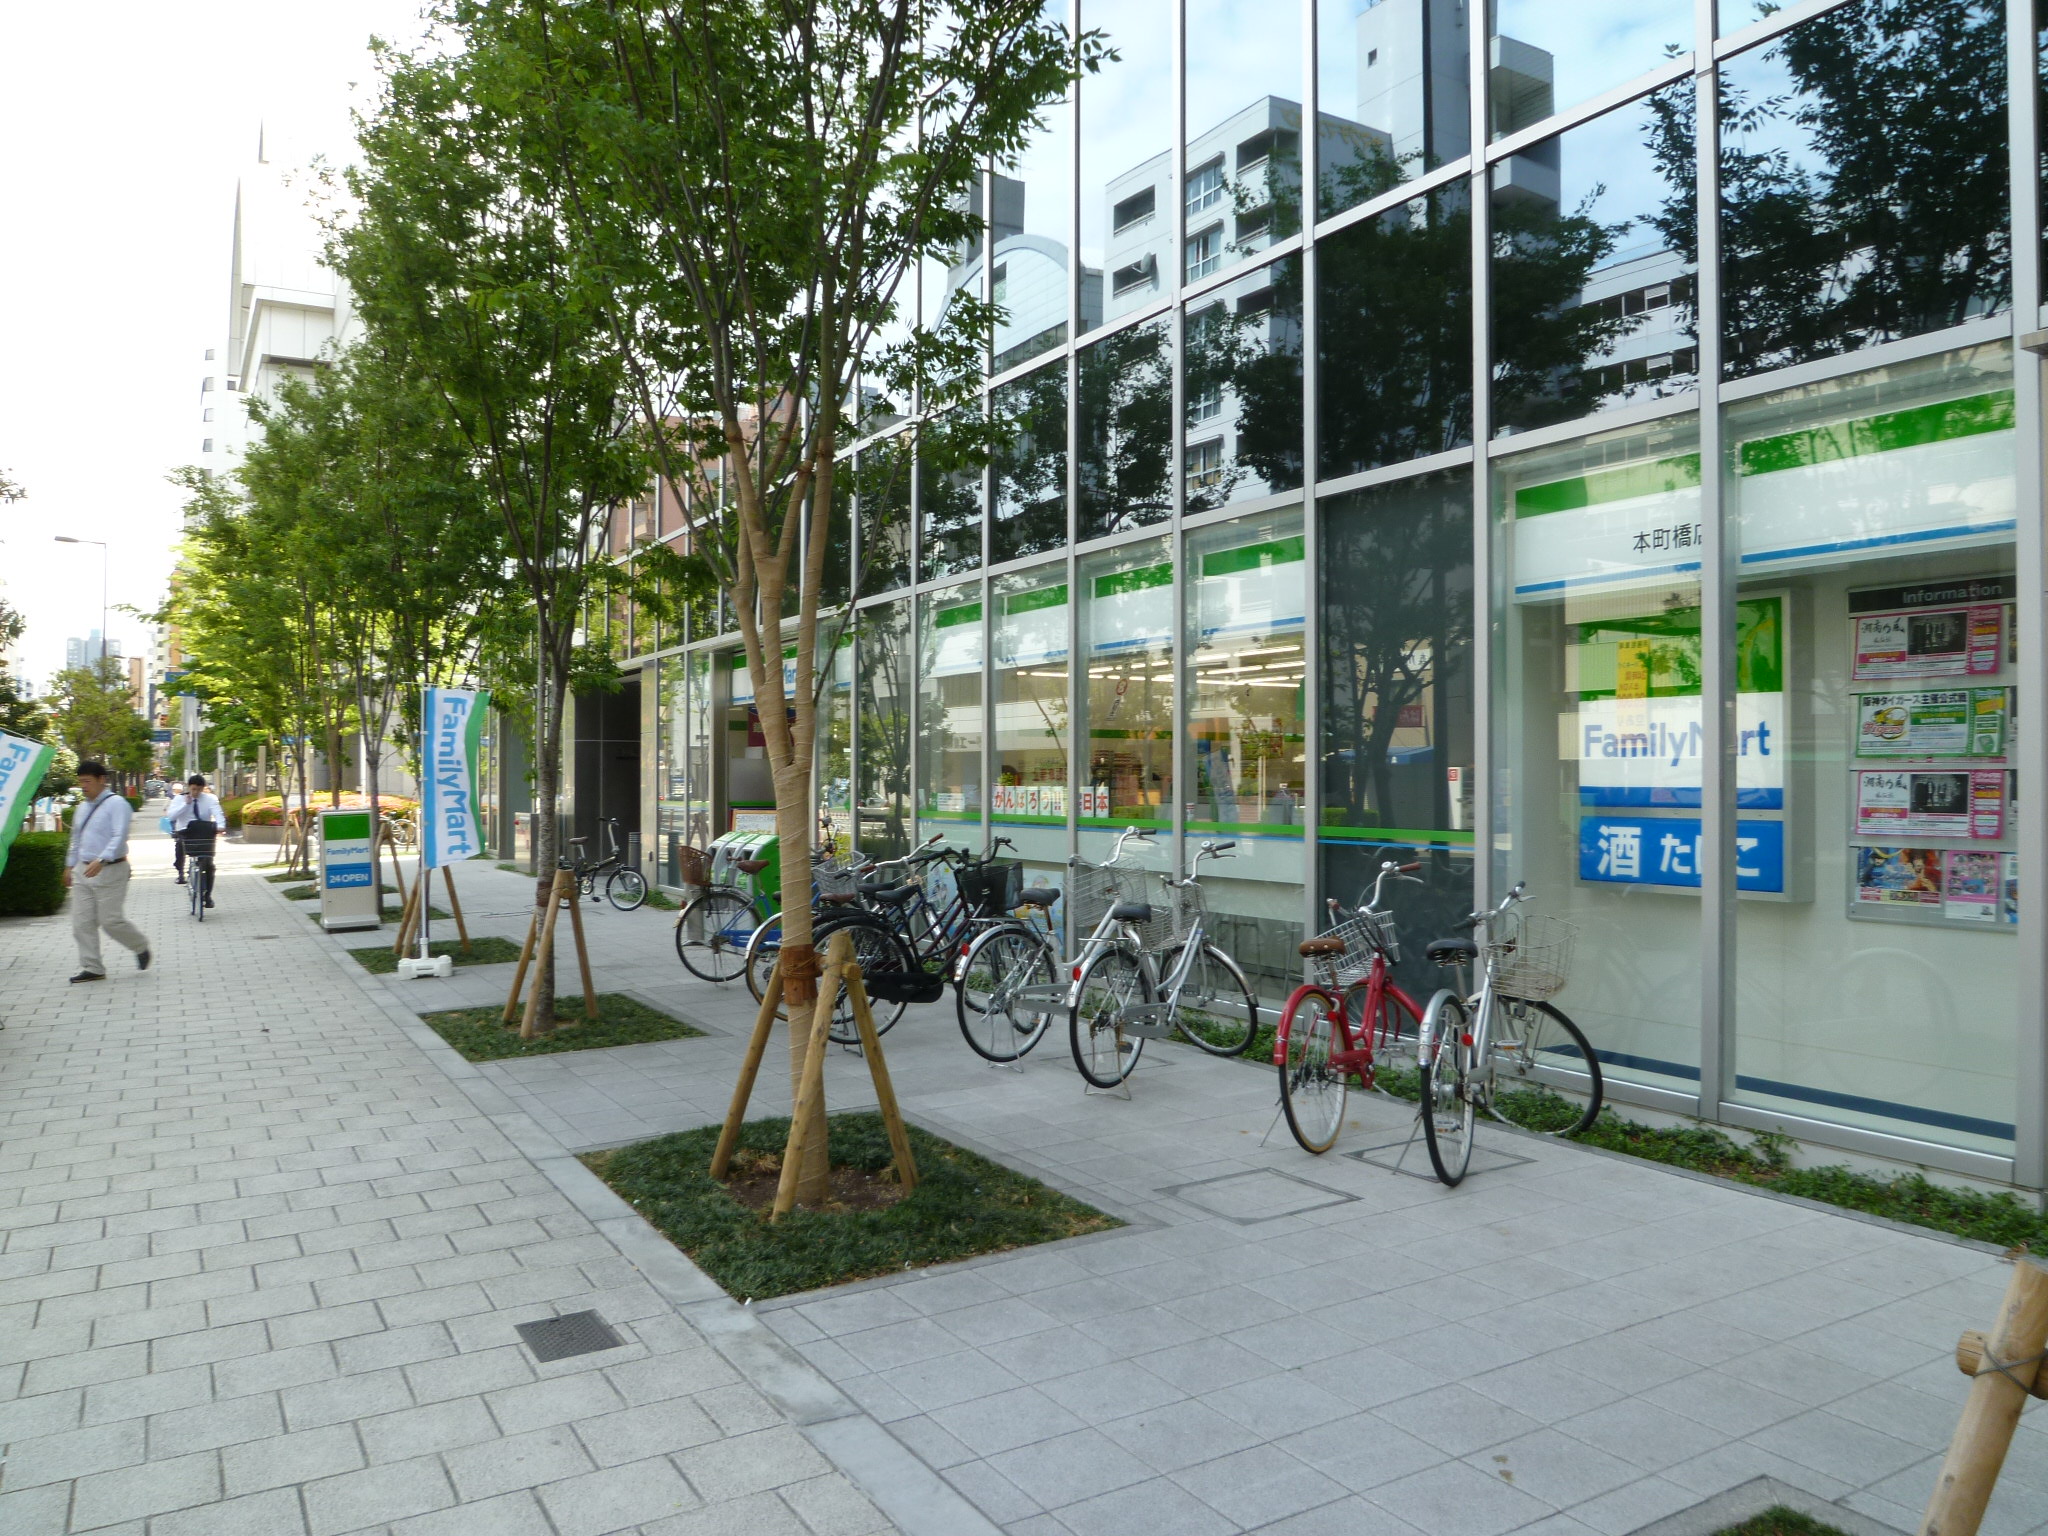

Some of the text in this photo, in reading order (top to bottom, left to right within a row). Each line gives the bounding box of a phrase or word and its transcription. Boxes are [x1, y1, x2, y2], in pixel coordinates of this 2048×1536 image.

[1903, 584, 2003, 603] Information
[1584, 720, 1771, 766] Familyrt
[436, 695, 473, 856] FamilyMart
[1083, 792, 1109, 812] 日本
[327, 846, 369, 856] FamilyMart
[1597, 824, 1760, 878] 酒 たこ
